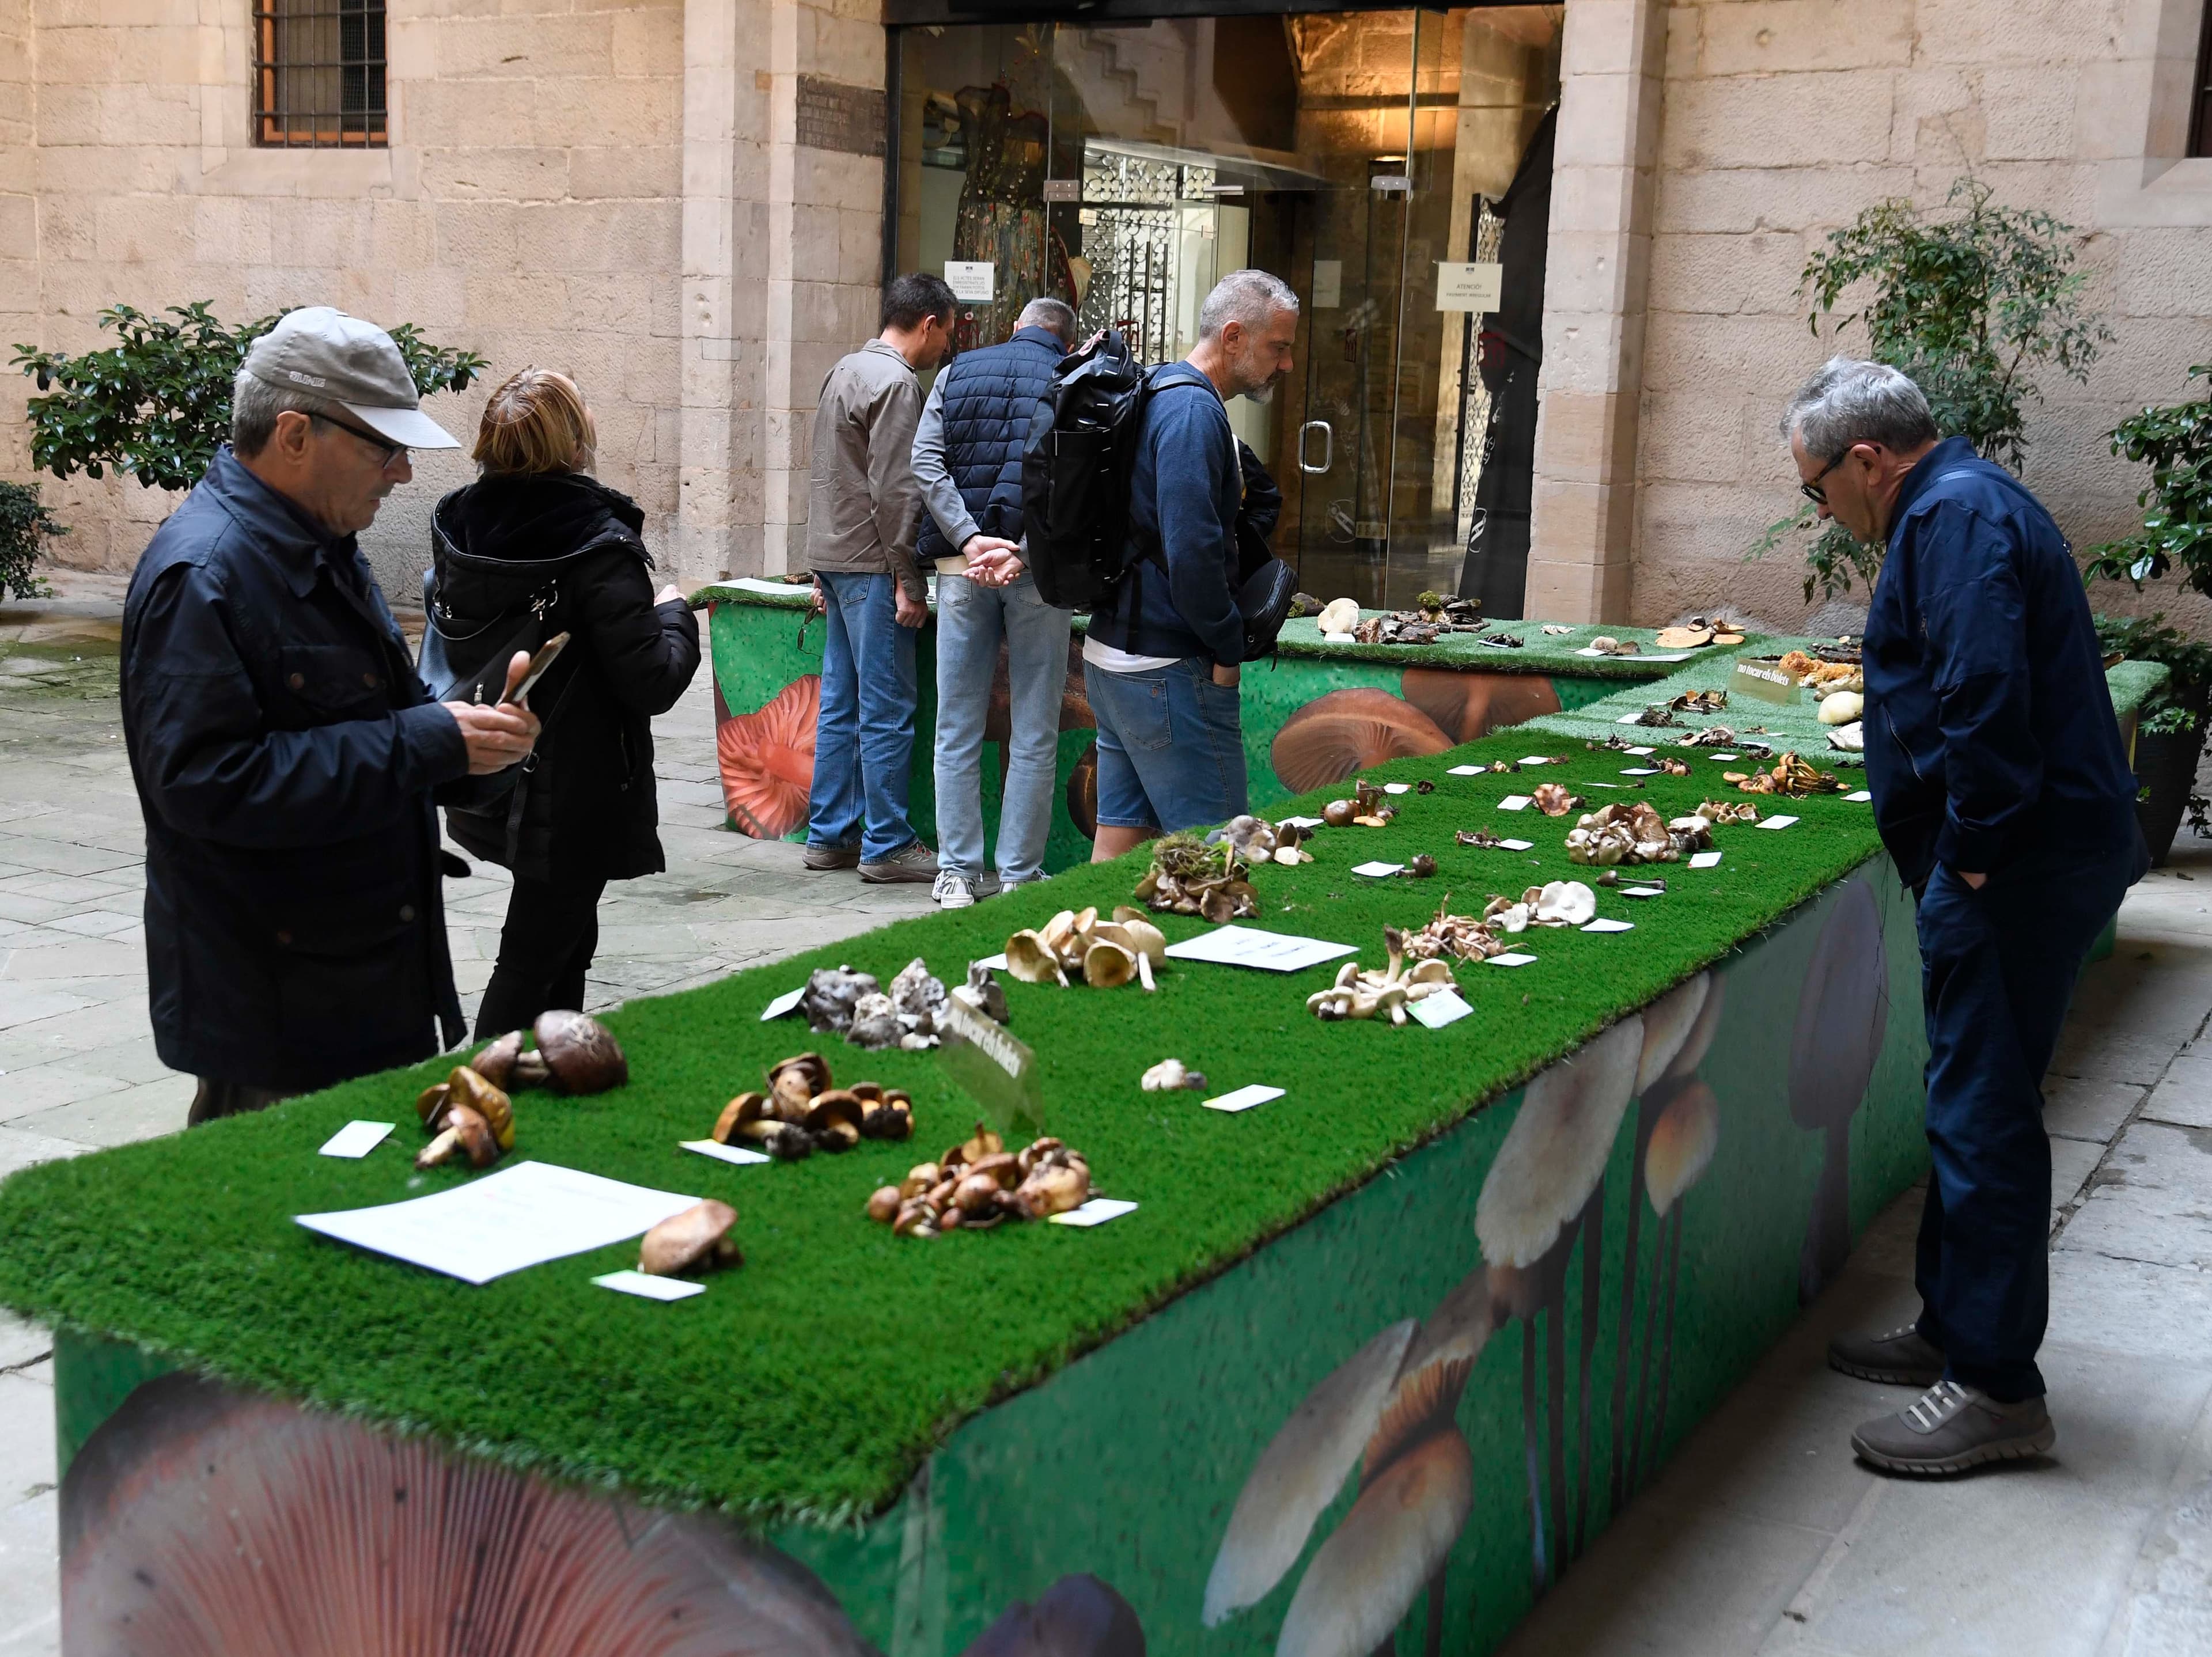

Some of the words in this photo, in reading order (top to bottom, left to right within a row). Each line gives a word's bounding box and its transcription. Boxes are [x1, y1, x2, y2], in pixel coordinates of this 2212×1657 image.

[1737, 664, 1747, 673] no
[1745, 665, 1763, 678] tocar
[1762, 669, 1771, 680] els
[1770, 670, 1789, 686] bolets
